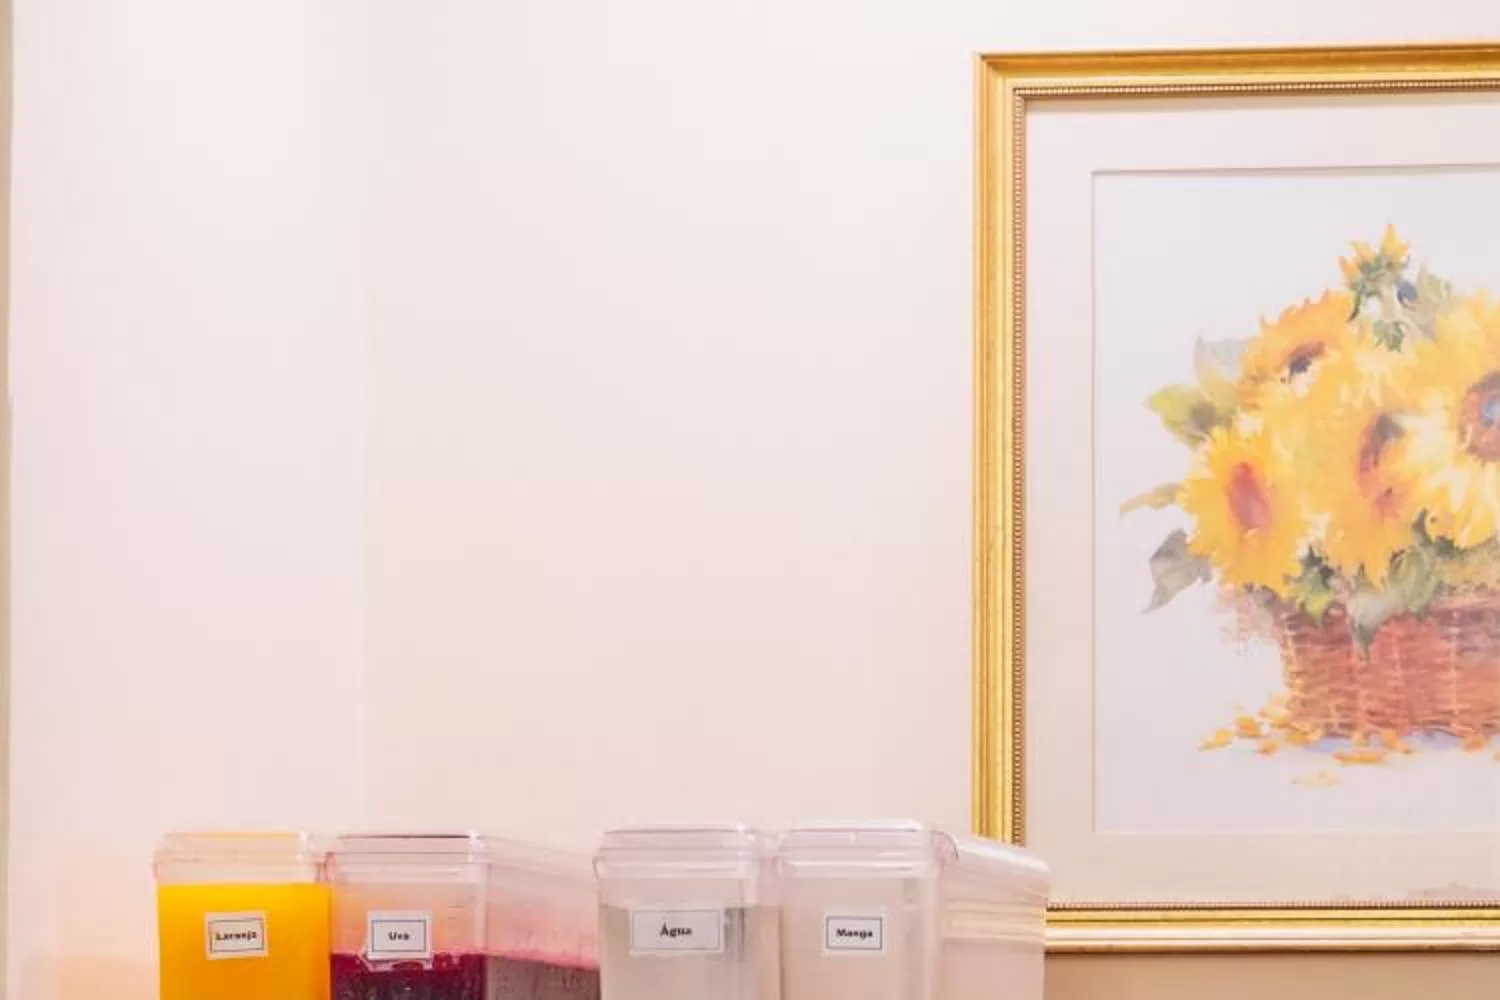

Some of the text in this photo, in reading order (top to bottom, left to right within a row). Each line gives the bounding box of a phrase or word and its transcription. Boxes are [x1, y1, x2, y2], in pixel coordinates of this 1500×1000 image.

[388, 931, 410, 941] Uva
[660, 923, 692, 938] Água
[836, 928, 874, 940] Manga
